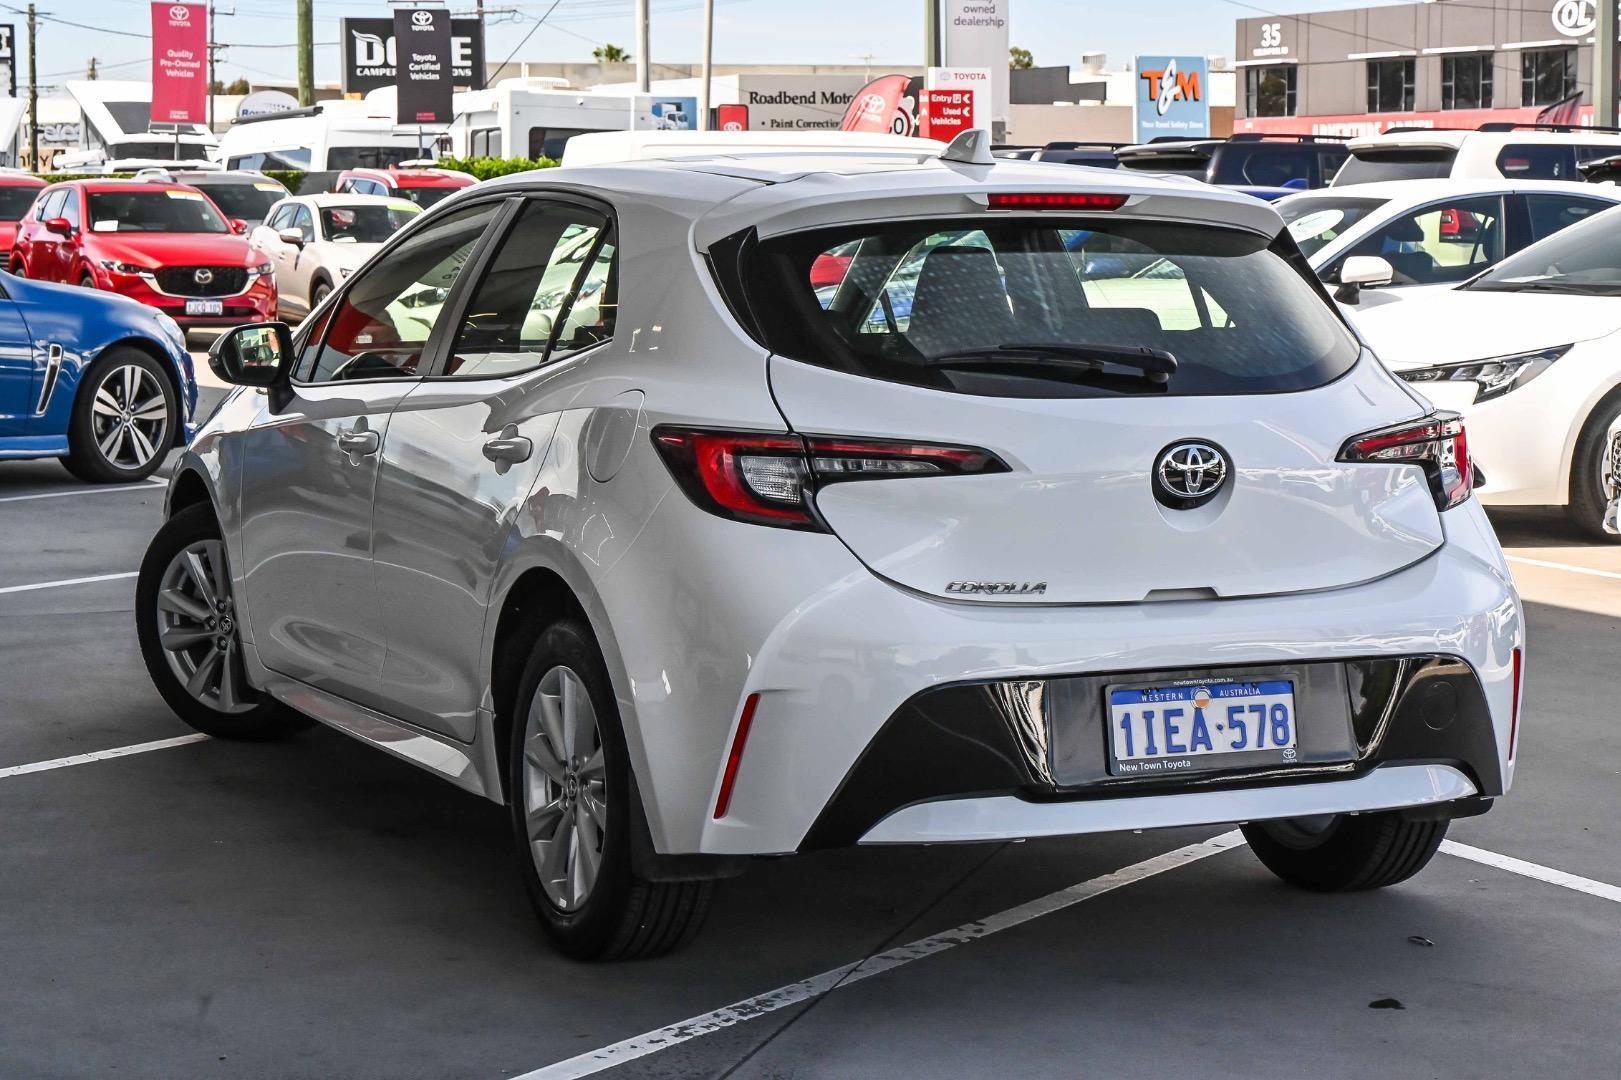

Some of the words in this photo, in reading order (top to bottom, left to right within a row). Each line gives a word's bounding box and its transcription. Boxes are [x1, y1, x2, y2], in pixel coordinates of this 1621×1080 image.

[963, 4, 996, 14] owned
[954, 16, 1005, 29] dealership
[1261, 23, 1281, 47] 35
[167, 49, 193, 60] Quality
[412, 54, 436, 62] Toyota
[160, 59, 200, 68] Pre-Owned
[409, 62, 440, 71] Certified
[166, 69, 194, 78] Vehicles
[410, 72, 440, 80] Vehicles
[954, 72, 986, 80] TOYOTA
[749, 91, 816, 104] Roadbend
[931, 94, 952, 104] Entry
[943, 107, 962, 115] Used
[771, 119, 793, 128] Paint
[796, 119, 840, 128] Correctio
[931, 117, 962, 125] Vehicles
[945, 582, 1047, 595] COROLLA
[1173, 677, 1234, 686] newtowntoyota.com.au
[1141, 693, 1183, 702] WESTERN
[1219, 687, 1261, 697] AUSTRALIA
[1119, 763, 1138, 771] New
[1139, 762, 1161, 770] Town
[1163, 760, 1191, 770] Toyota
